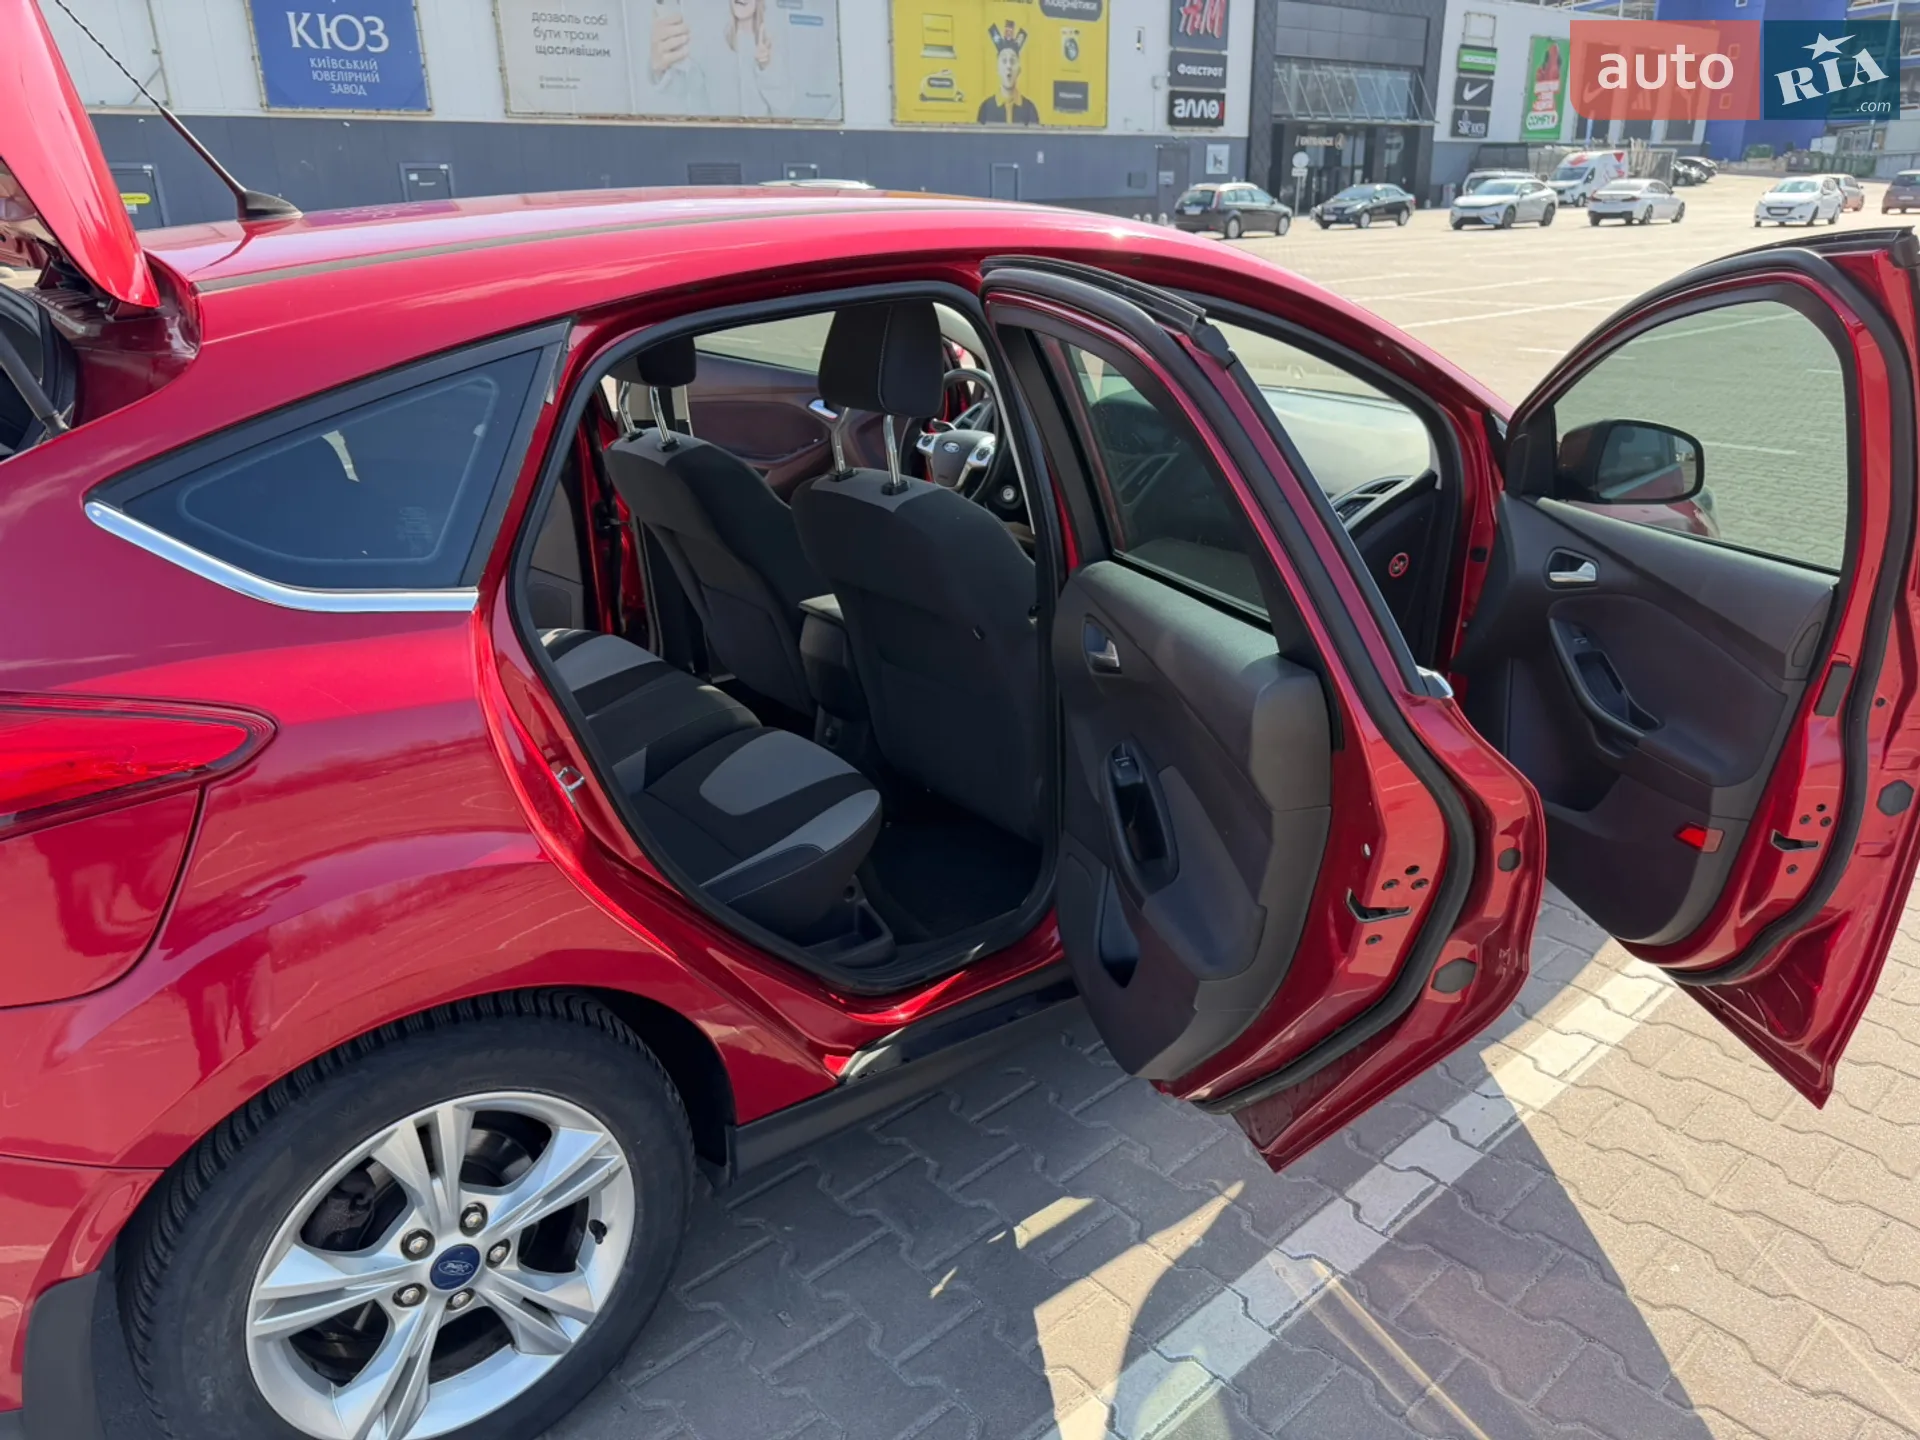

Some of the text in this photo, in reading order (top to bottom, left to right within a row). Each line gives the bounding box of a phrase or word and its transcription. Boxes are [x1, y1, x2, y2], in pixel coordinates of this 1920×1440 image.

[531, 12, 608, 25] дозволь собі
[286, 11, 390, 53] КЮЗ
[533, 26, 599, 42] бути трохи
[535, 44, 611, 57] щасливішим
[309, 56, 378, 70] КИЇВСЬКИЙ
[312, 70, 380, 83] ЮВЕЛІРНИЙ
[330, 83, 367, 96] ЗАВОД
